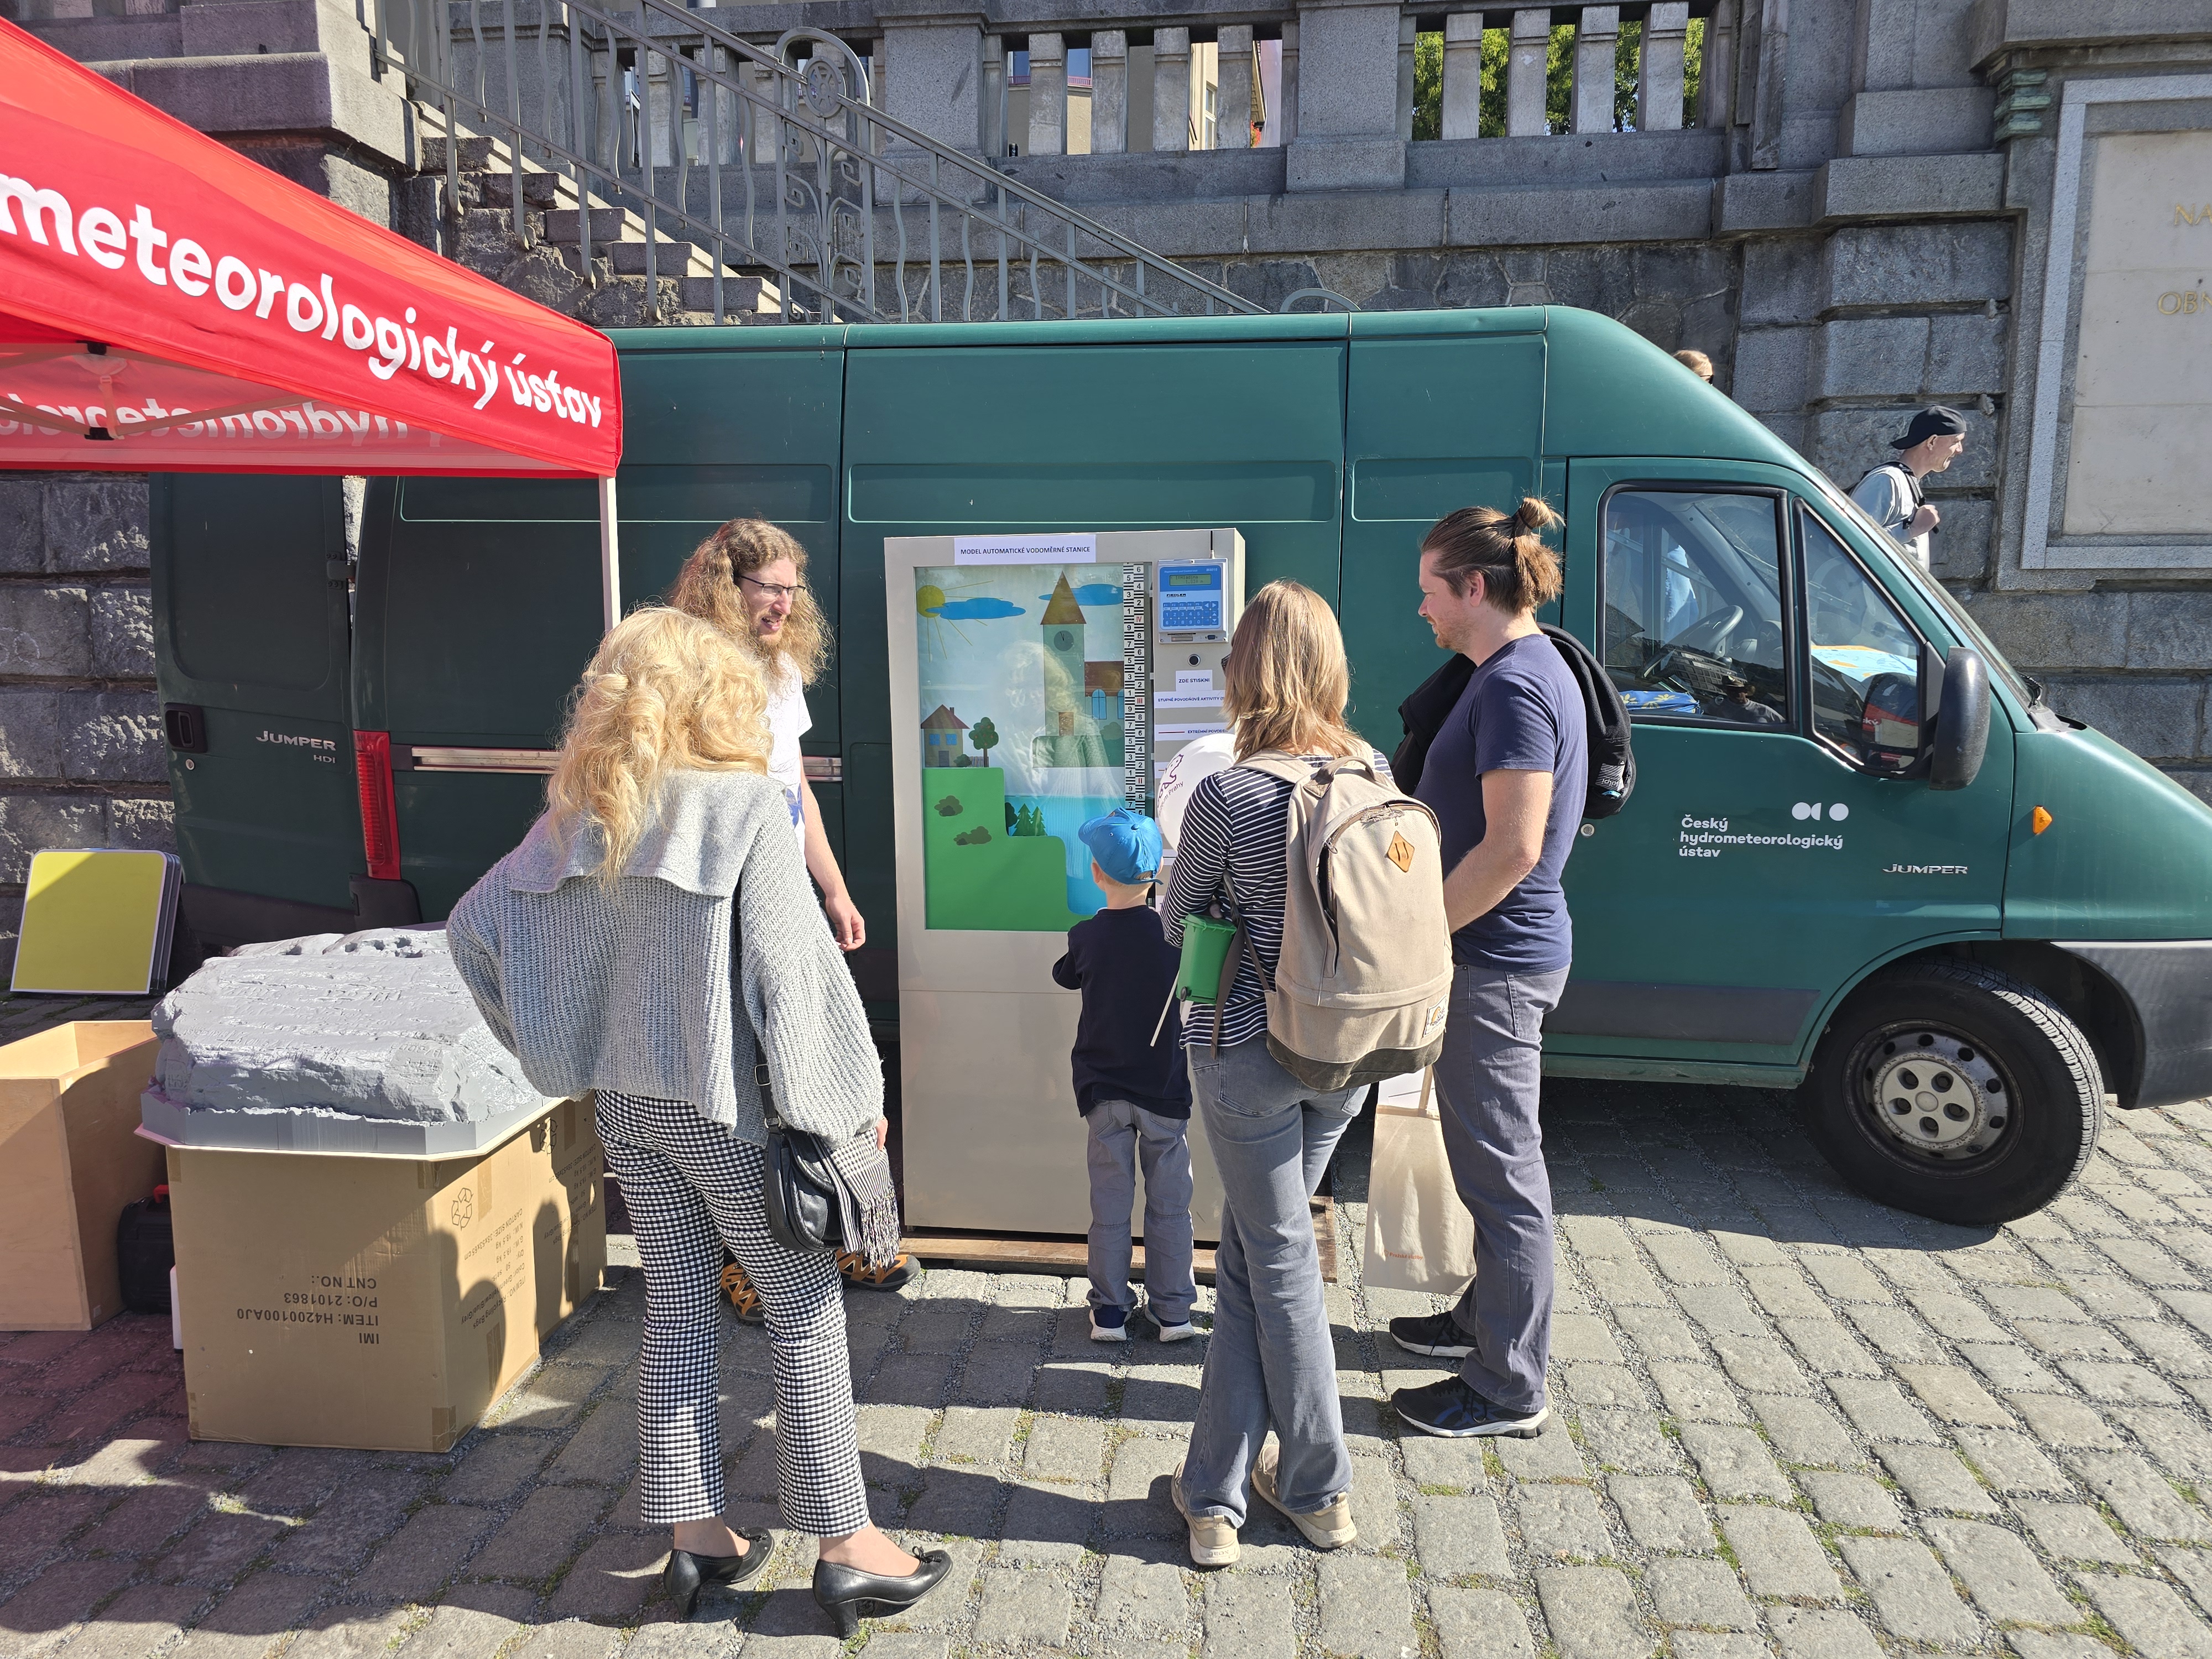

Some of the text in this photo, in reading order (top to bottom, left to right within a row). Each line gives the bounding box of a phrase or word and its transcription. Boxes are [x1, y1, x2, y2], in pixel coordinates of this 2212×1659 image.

[0, 173, 602, 429] meteorologický ústav
[256, 731, 336, 751] JUMPER
[1168, 781, 1183, 795] Prahy
[1681, 814, 1728, 832] Český
[1680, 831, 1843, 850] hydrometeorologický
[1679, 846, 1720, 857] ústav
[1882, 863, 1968, 874] JUMPER
[583, 1143, 596, 1159] CARTON
[465, 1208, 523, 1260] CARTON SIZE: 38x53x65 cm
[496, 1240, 501, 1249] kg
[497, 1255, 502, 1264] kg
[346, 1277, 377, 1289] CNT
[516, 1276, 525, 1291] ITEM
[284, 1292, 378, 1308] P/O: 2101863
[486, 1295, 506, 1318] Recycling
[237, 1308, 378, 1326] ITEM: H4200100AJ0
[473, 1315, 485, 1329] Bags
[359, 1333, 379, 1344] IMI
